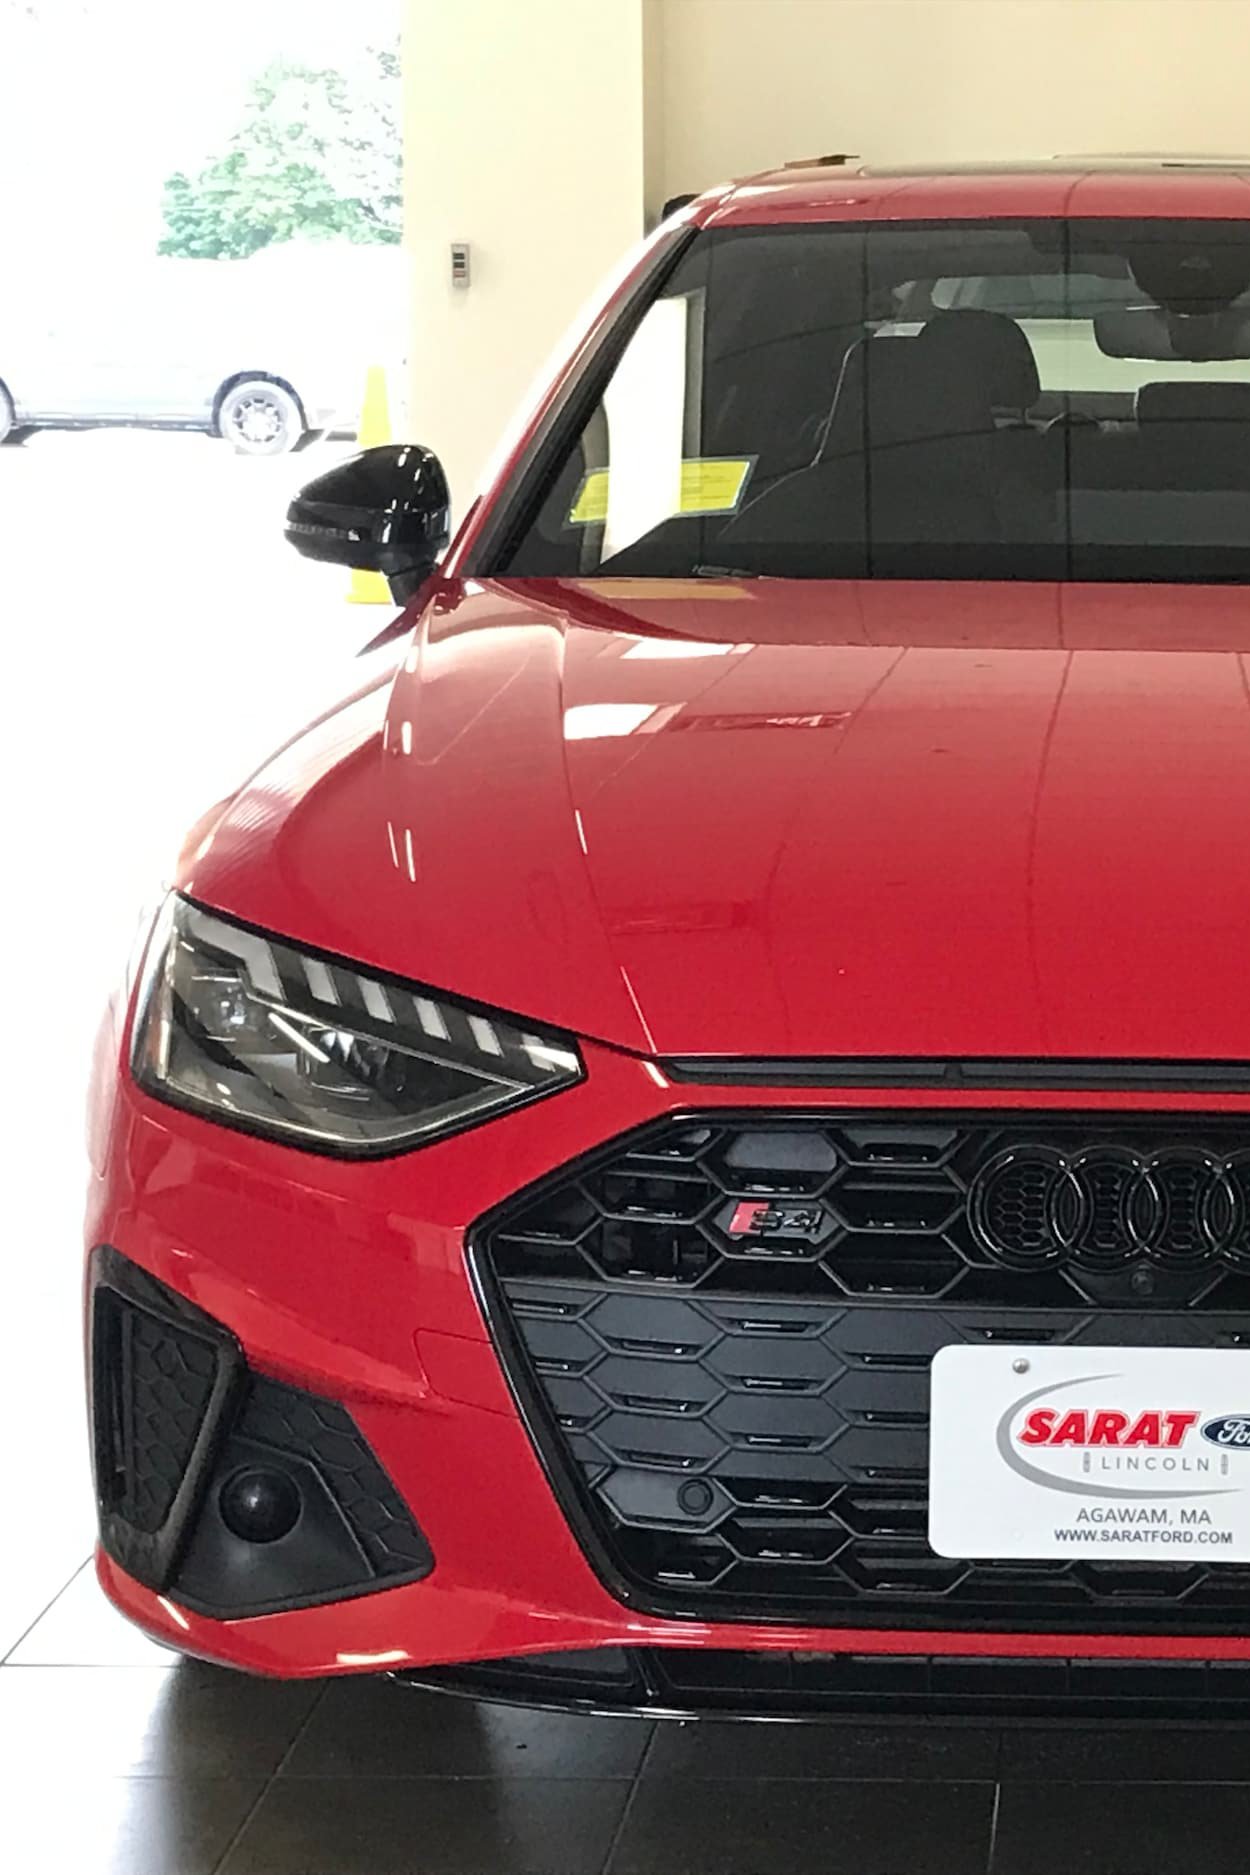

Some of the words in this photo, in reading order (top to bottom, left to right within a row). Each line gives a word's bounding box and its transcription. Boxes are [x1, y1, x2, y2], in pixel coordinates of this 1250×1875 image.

[1017, 1409, 1201, 1448] SARAT
[1101, 1456, 1210, 1472] LINCOLN
[1075, 1507, 1174, 1526] AGAWAM,
[1180, 1508, 1213, 1525] MA
[1053, 1528, 1234, 1544] WWW.SARATFORD.COM
